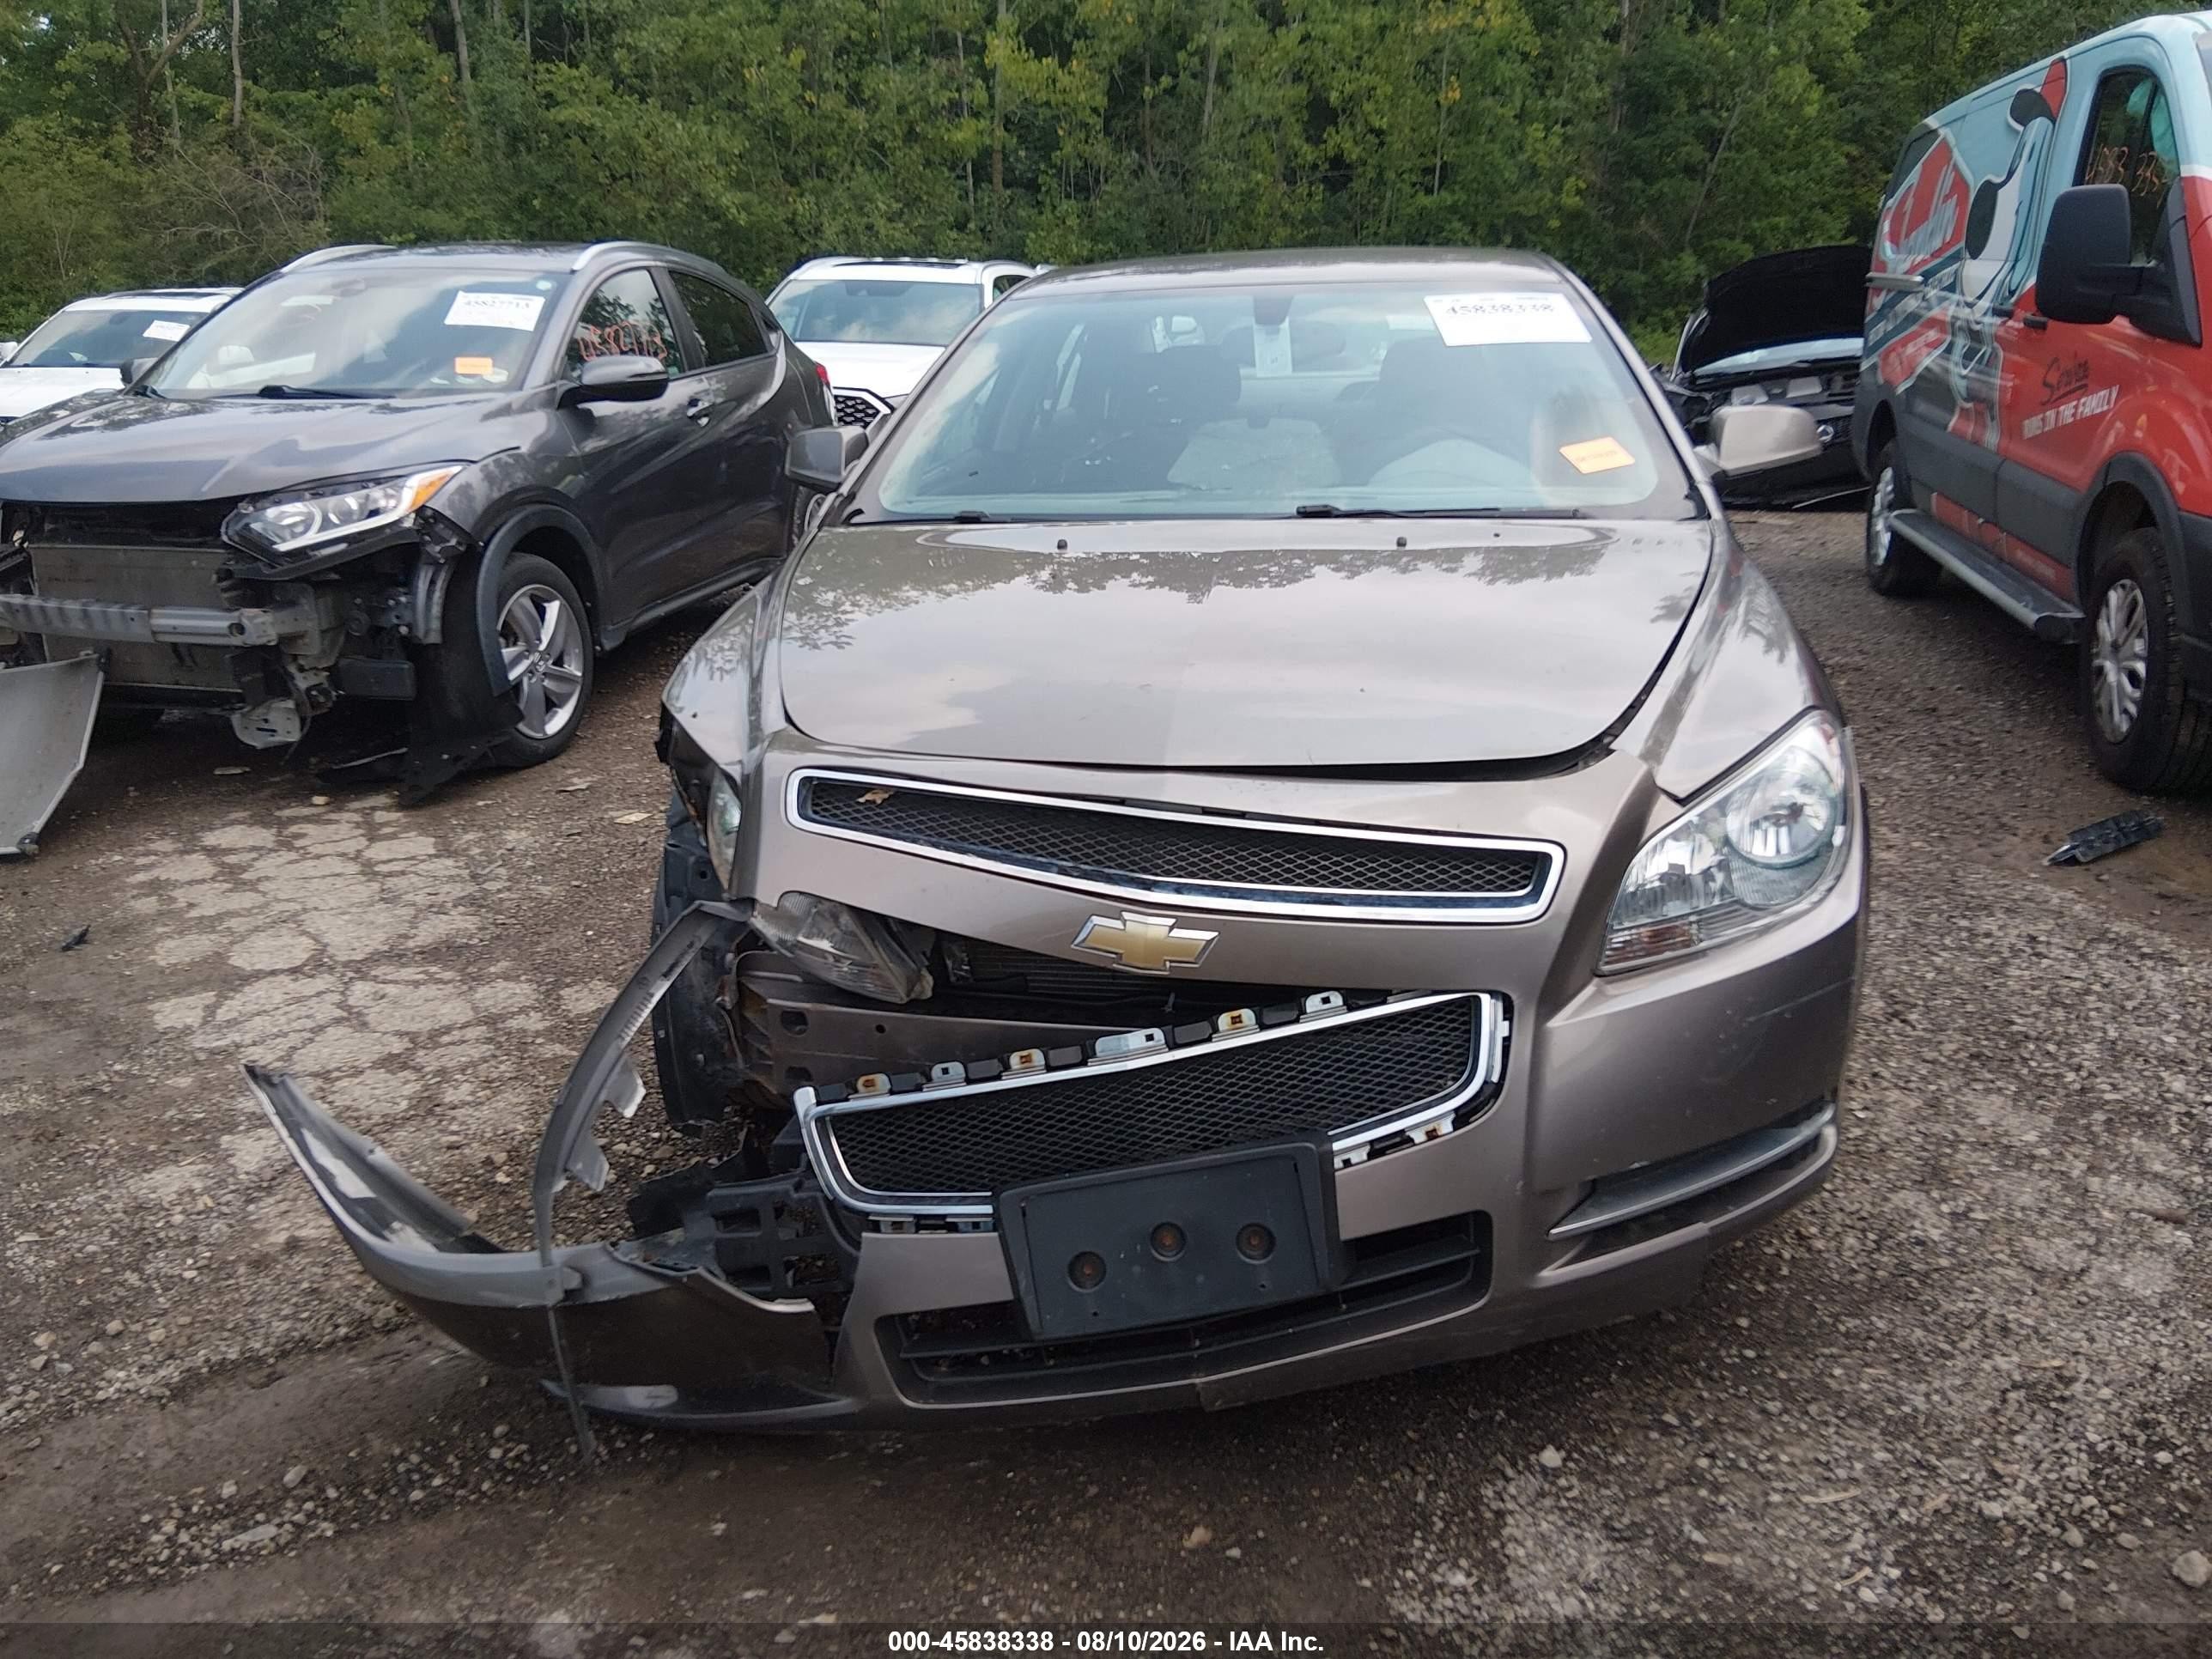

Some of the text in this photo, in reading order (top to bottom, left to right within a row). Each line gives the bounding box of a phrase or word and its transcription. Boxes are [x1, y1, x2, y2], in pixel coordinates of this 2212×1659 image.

[1446, 304, 1554, 315] 45838338
[2056, 400, 2078, 427] THE
[2075, 385, 2121, 420] FAMILY
